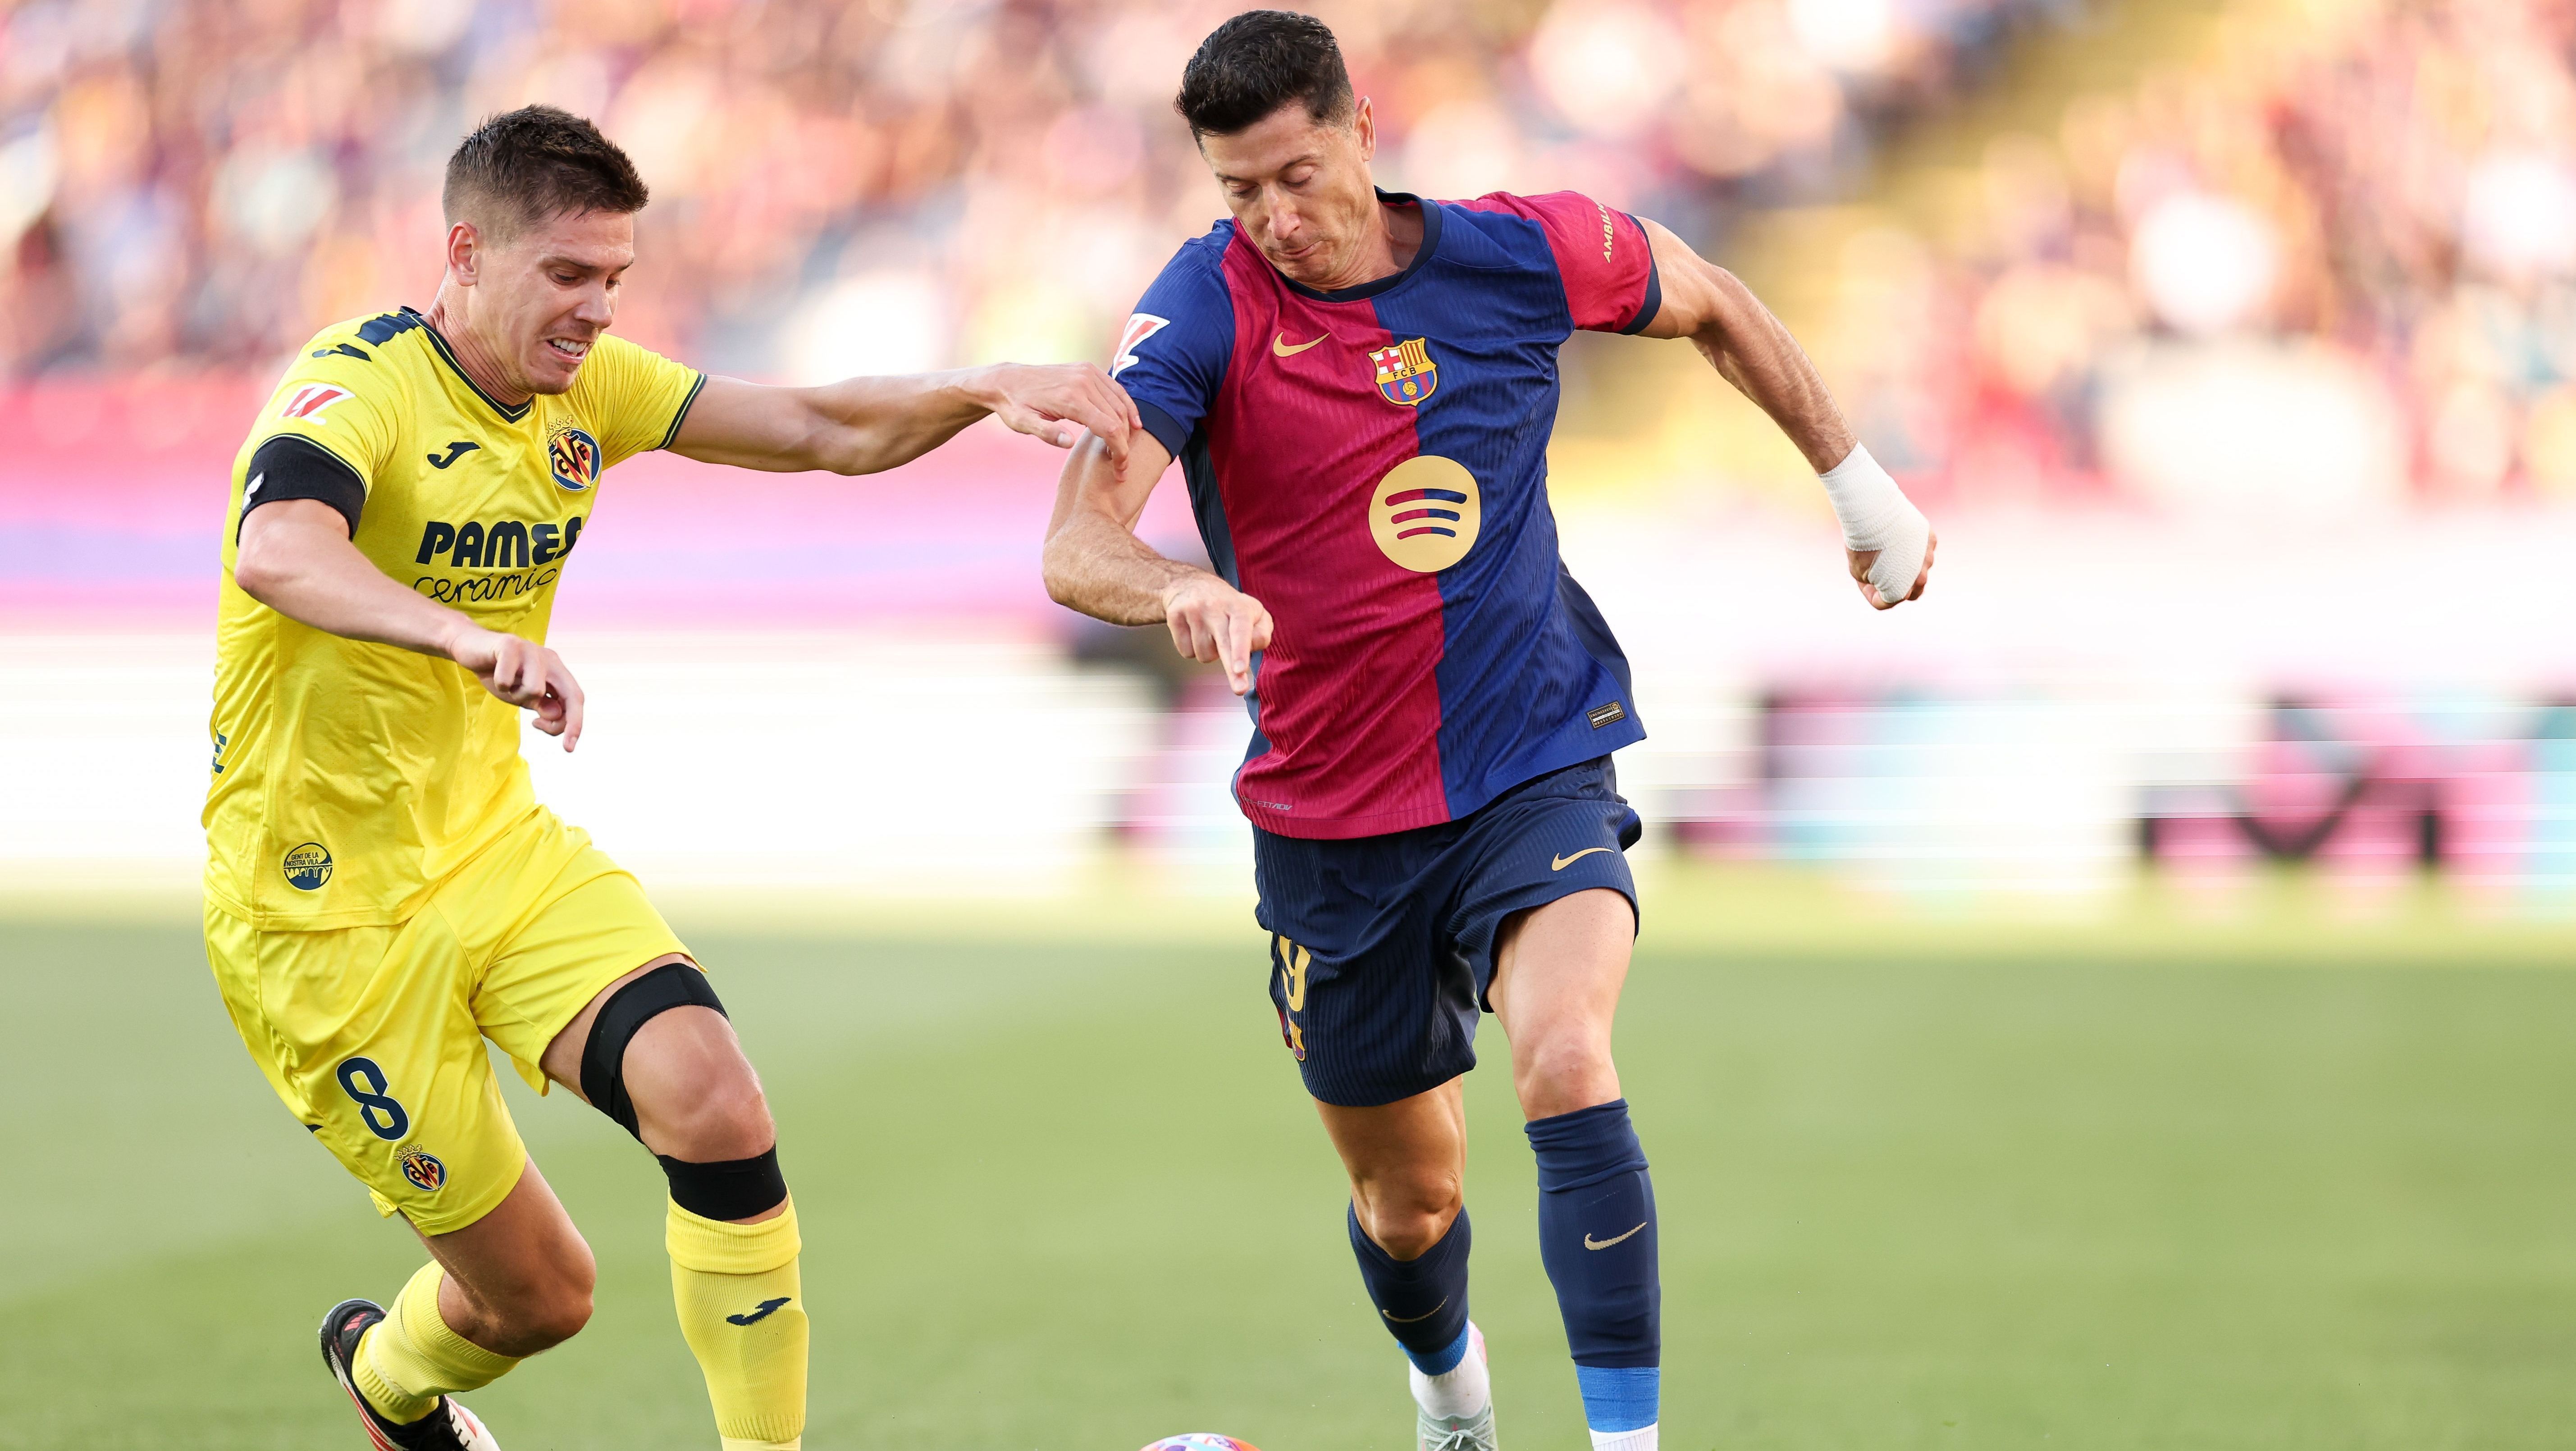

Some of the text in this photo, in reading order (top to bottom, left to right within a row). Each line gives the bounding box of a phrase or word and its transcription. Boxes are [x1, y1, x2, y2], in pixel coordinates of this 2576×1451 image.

[1393, 367, 1416, 379] FCB
[1279, 935, 1311, 1012] 9
[336, 1056, 410, 1141] 8
